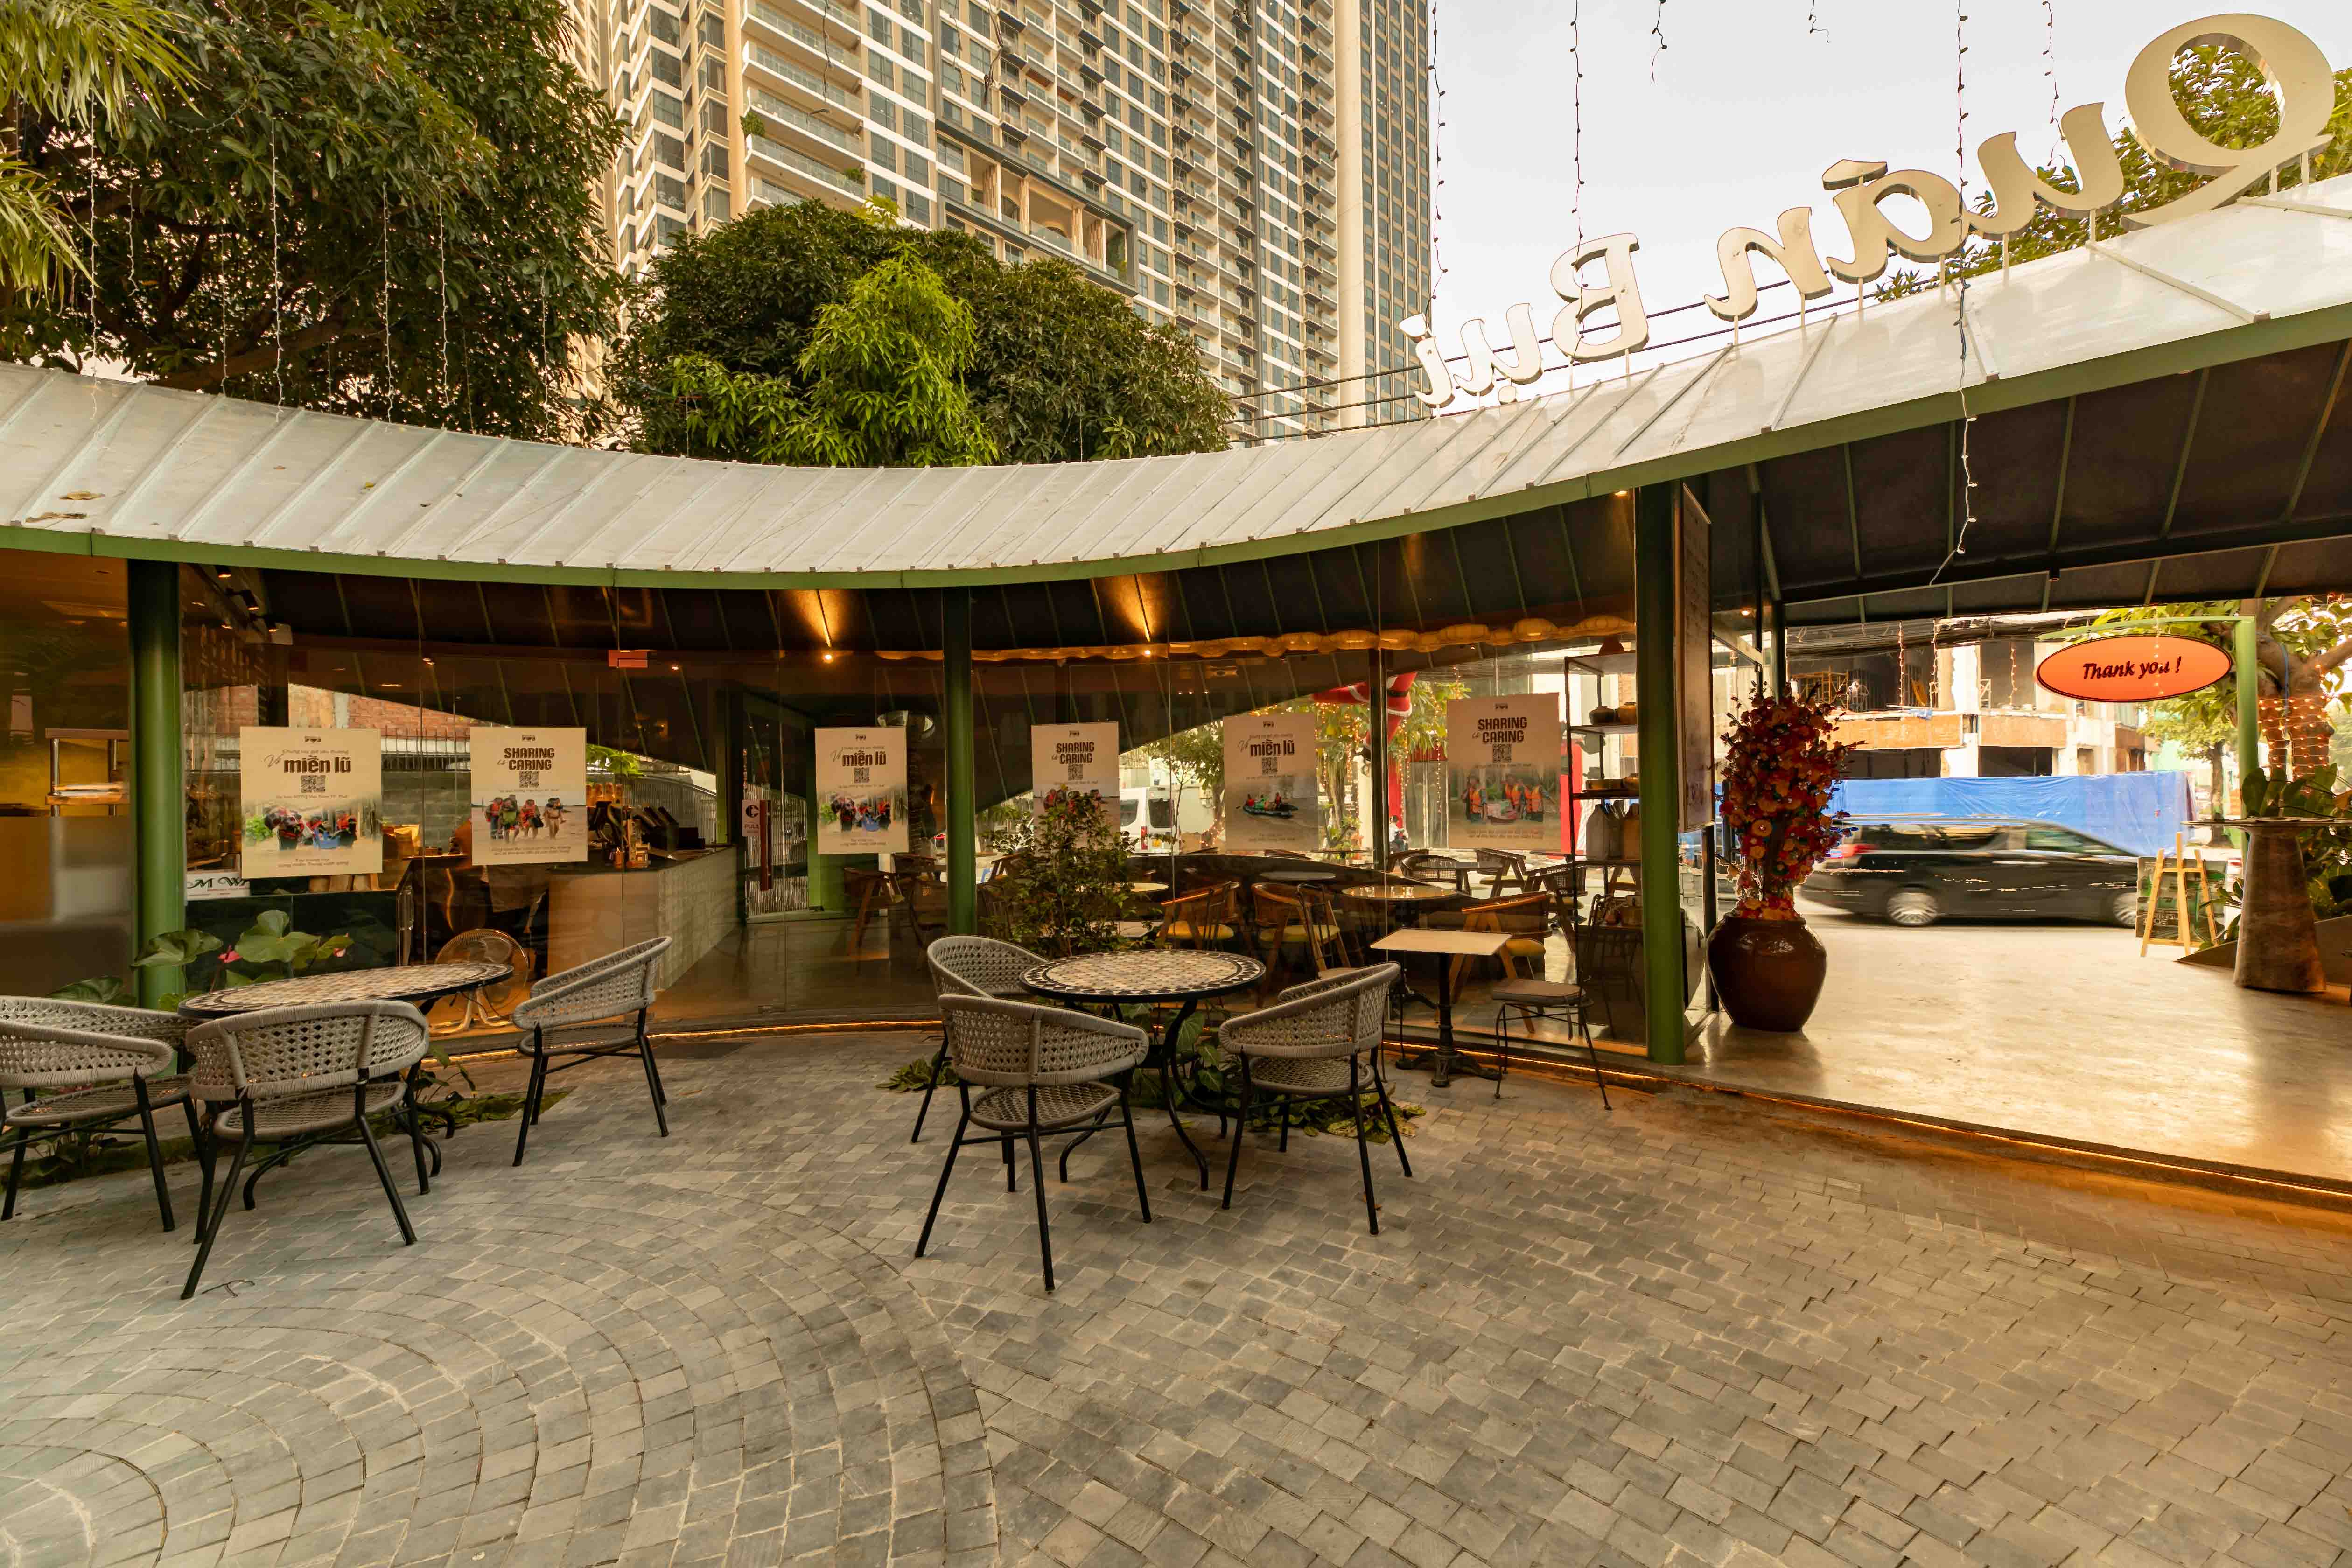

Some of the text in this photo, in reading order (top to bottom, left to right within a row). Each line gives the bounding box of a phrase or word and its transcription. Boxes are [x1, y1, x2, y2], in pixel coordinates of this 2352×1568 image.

[2083, 660, 2135, 680] Thank
[2138, 661, 2170, 679] you
[1478, 716, 1527, 730] SHARING
[1482, 730, 1524, 743] CARING
[504, 747, 555, 759] SHARING
[1056, 742, 1094, 754] SHARING
[1250, 739, 1281, 756] miền
[1283, 740, 1295, 755] lũ
[283, 755, 331, 773] miền
[334, 756, 351, 773] lũ
[508, 759, 552, 770] CARING
[842, 750, 873, 766] miền
[875, 750, 886, 766] lũ
[1060, 753, 1092, 764] CARING
